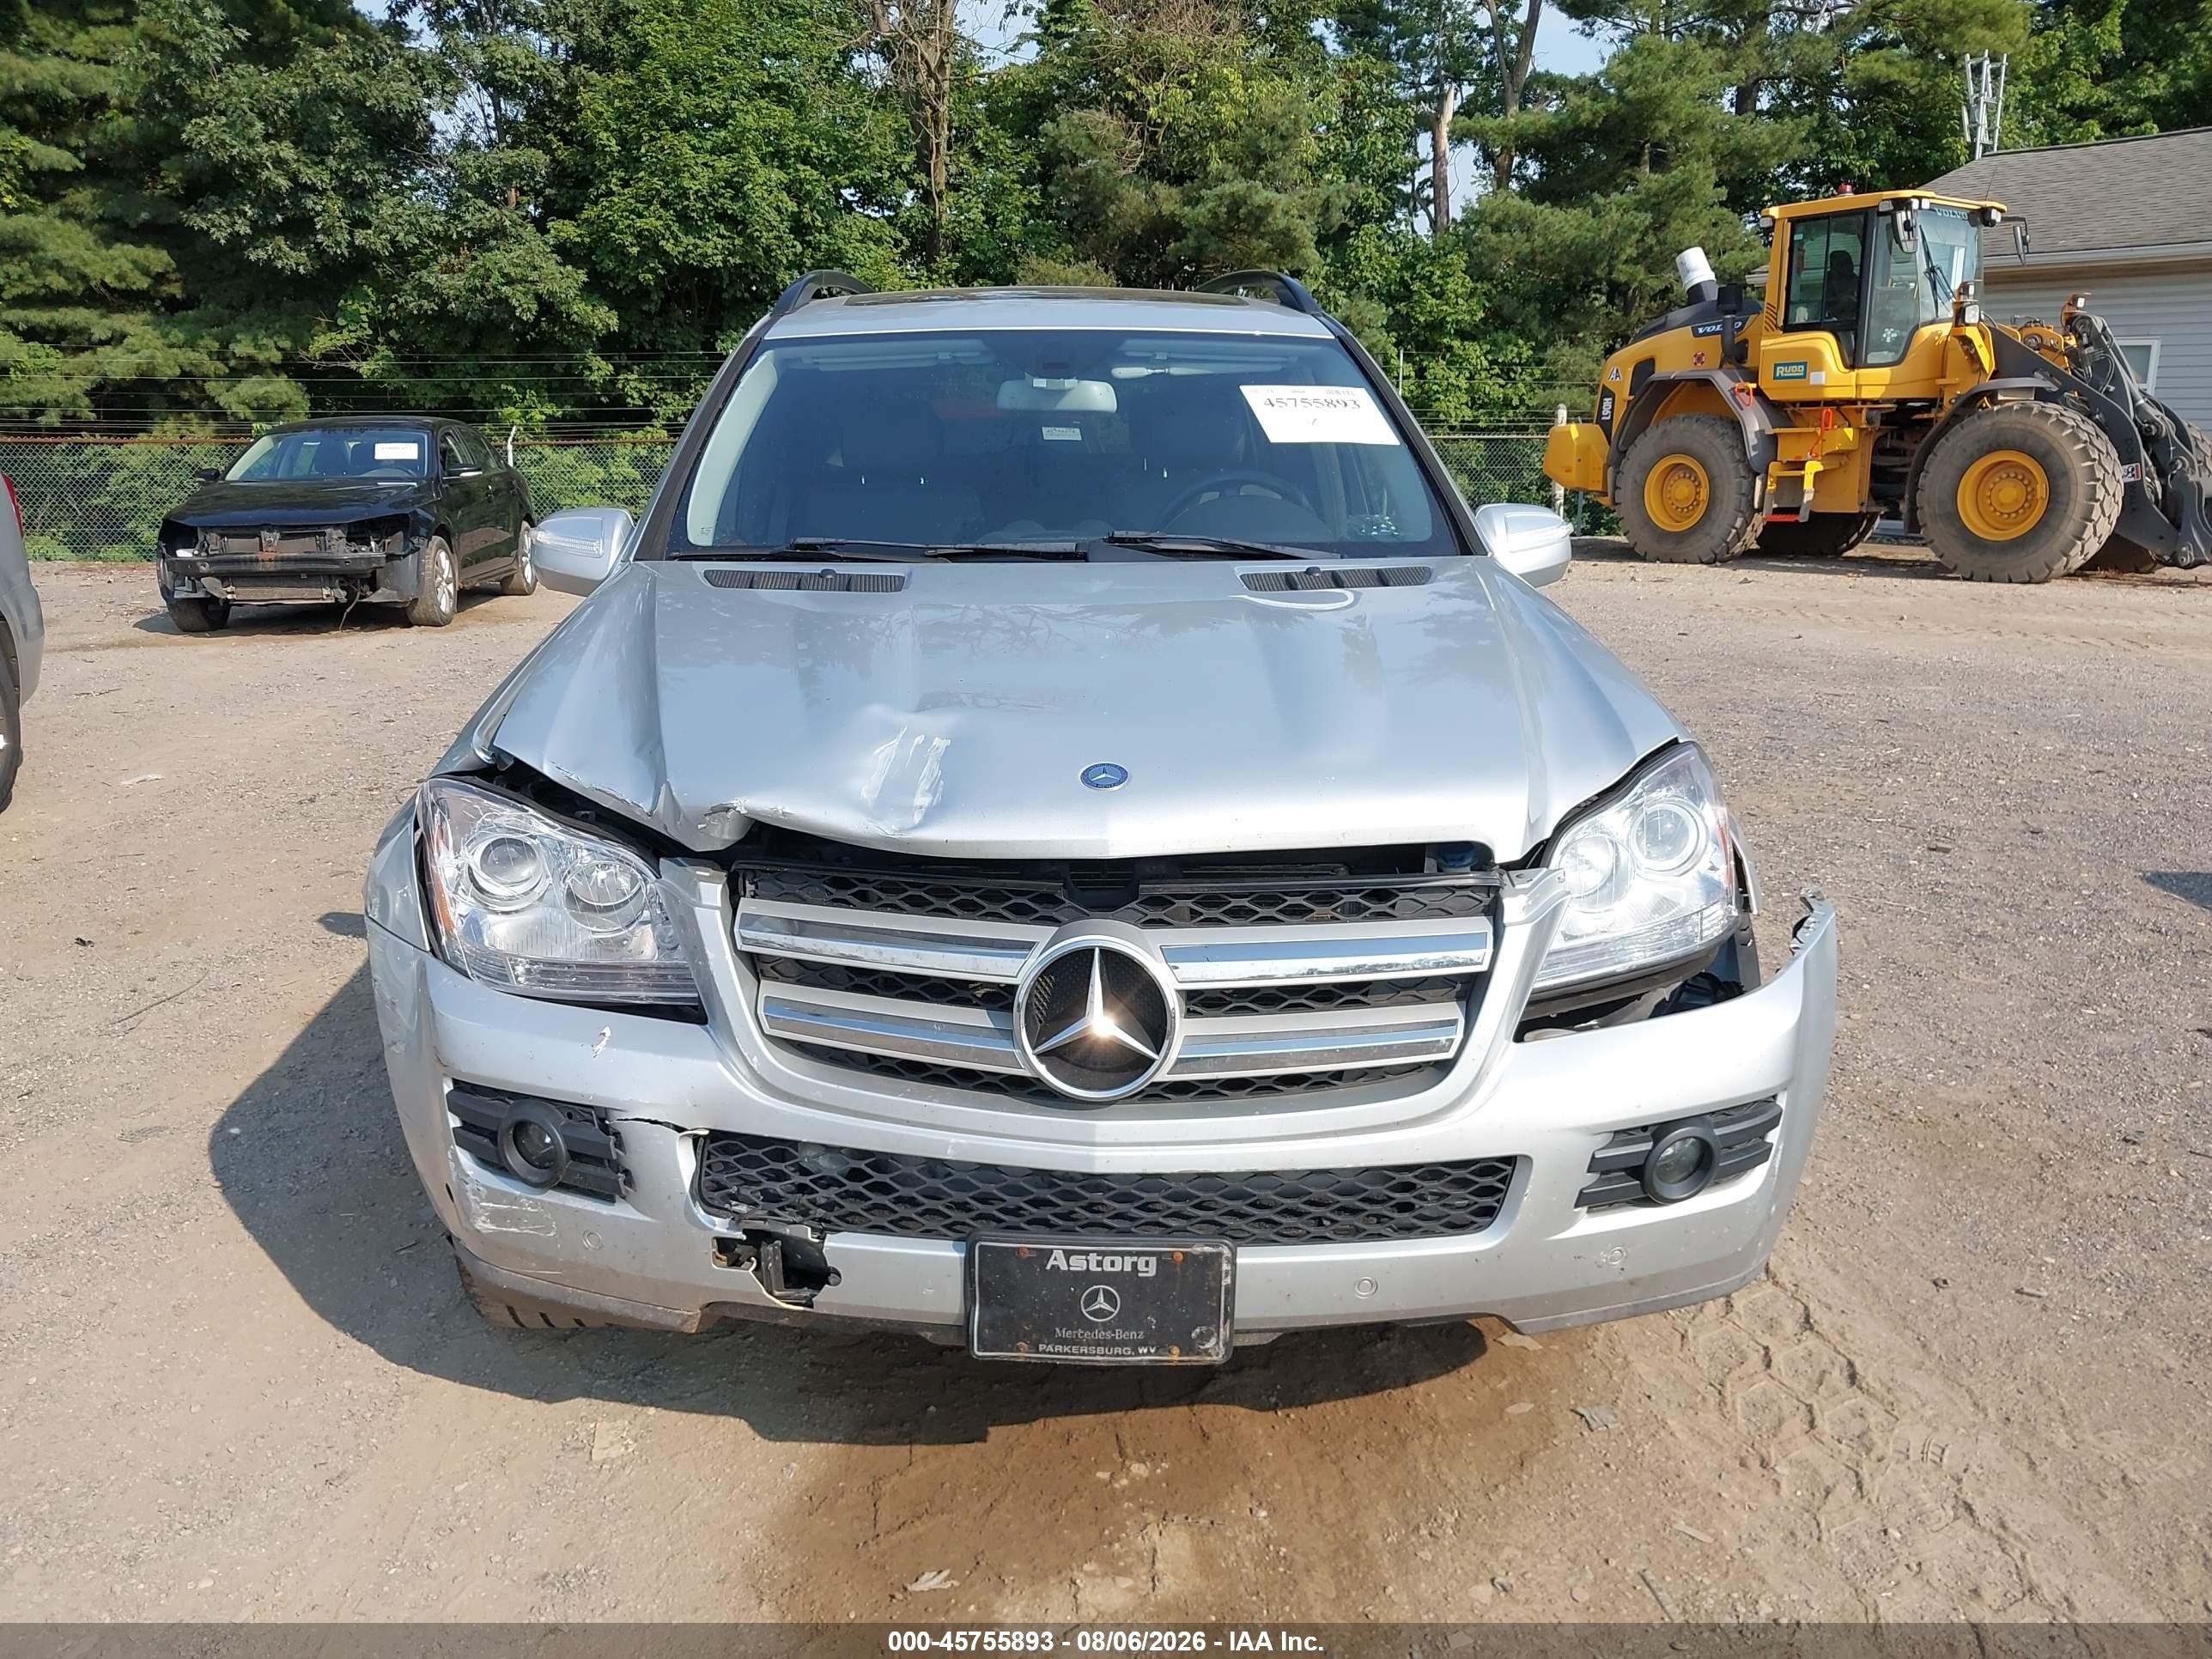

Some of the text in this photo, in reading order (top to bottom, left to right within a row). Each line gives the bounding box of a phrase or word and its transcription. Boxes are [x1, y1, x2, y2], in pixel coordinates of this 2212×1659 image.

[1935, 208, 1968, 220] VOLVO
[1697, 321, 1742, 334] VOLO
[1776, 365, 1804, 377] RUDD
[1264, 398, 1361, 410] 45755893
[1601, 398, 1613, 420] L90H
[1046, 1249, 1158, 1277] Astorg
[1054, 1327, 1145, 1340] Mercedes-Benz
[1138, 1346, 1157, 1355] WV
